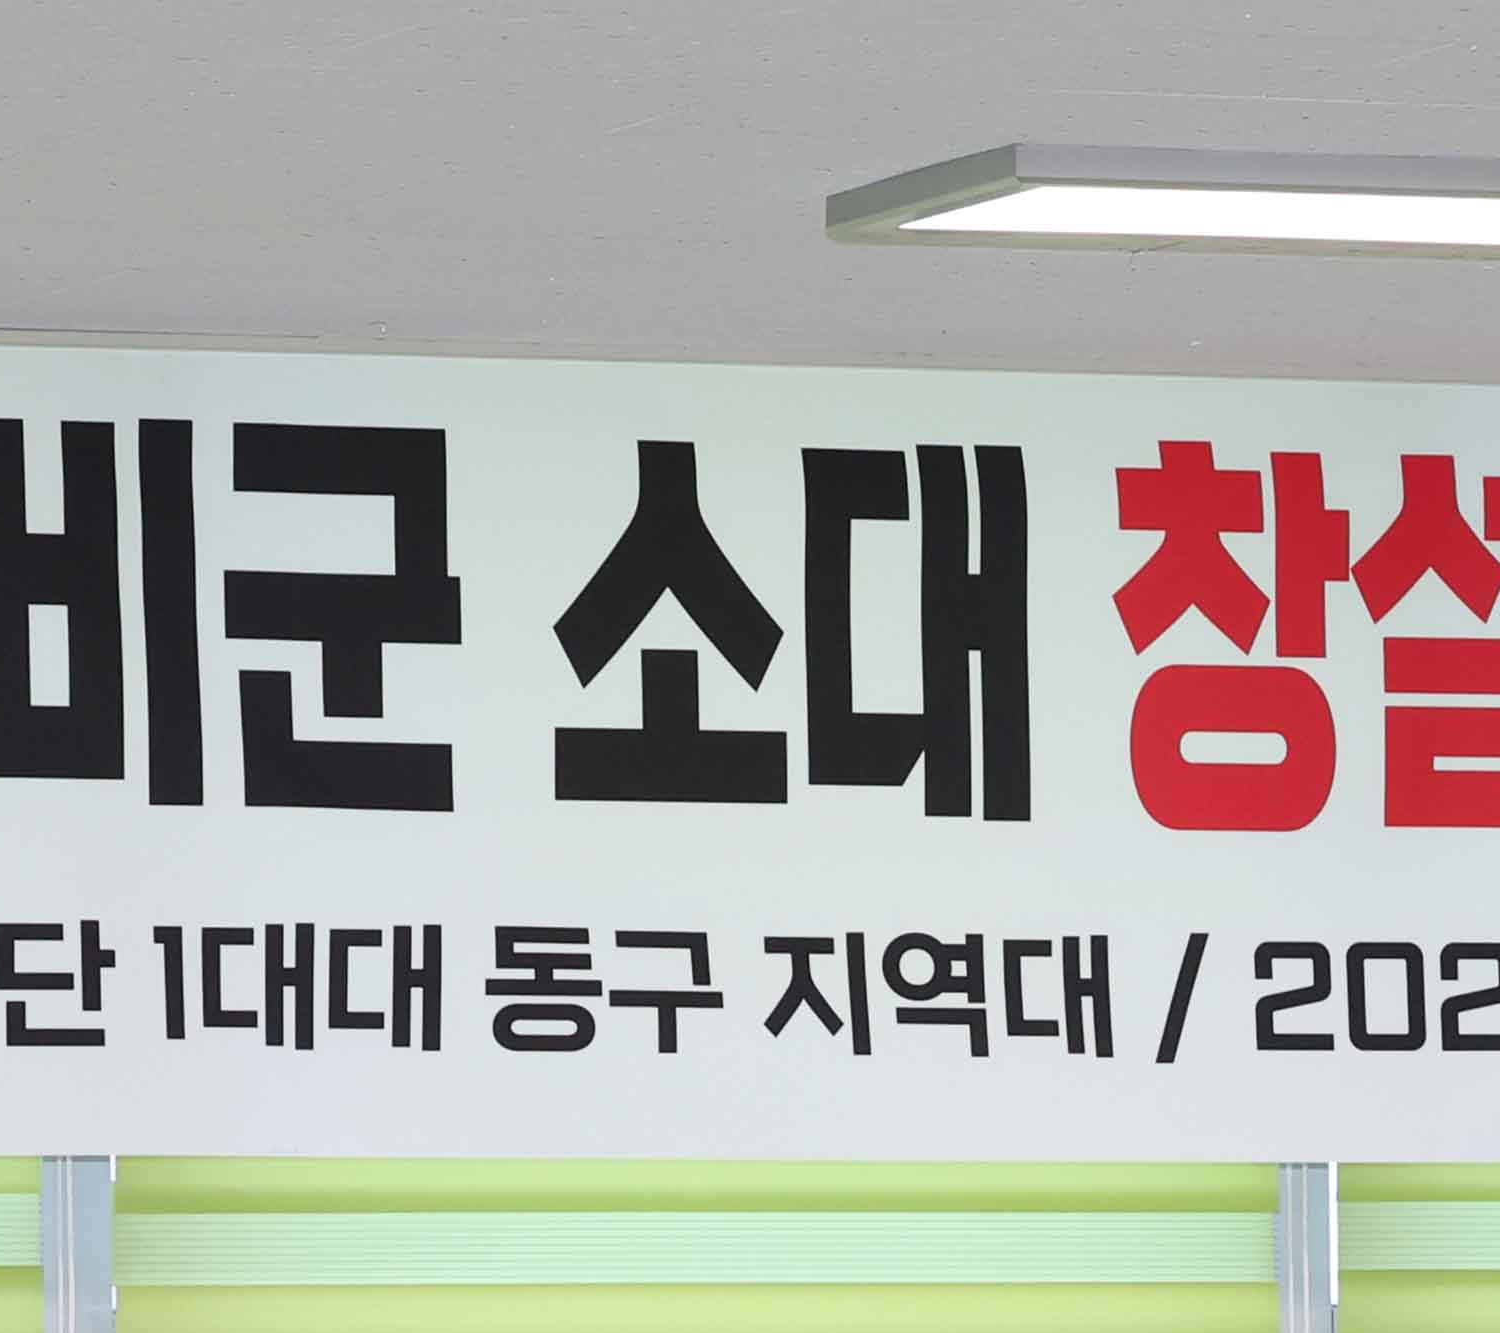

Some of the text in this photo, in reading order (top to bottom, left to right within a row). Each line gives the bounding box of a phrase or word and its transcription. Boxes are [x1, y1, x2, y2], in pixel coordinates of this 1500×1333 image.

[554, 440, 1030, 822] 소대
[154, 923, 441, 1052] 1대대
[486, 926, 723, 1053] 동구
[764, 933, 1113, 1058] 지역대
[1157, 933, 1208, 1063] /
